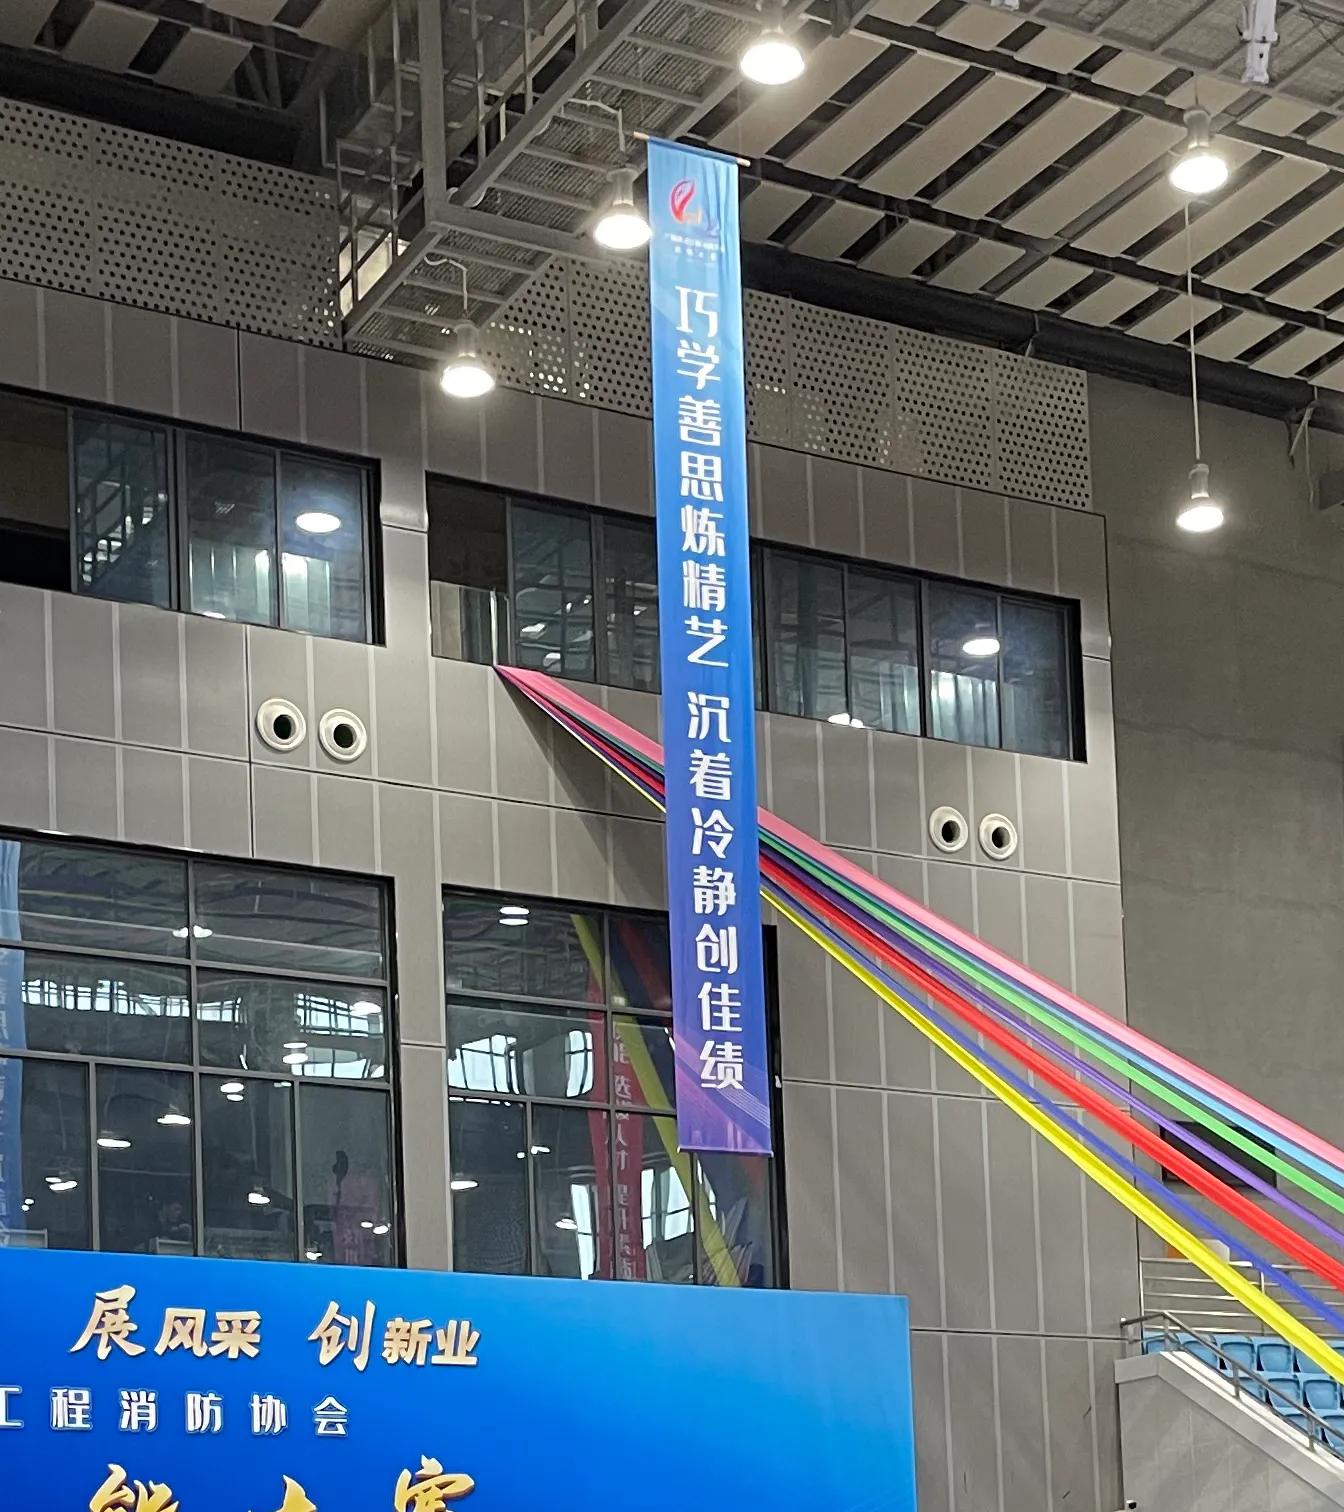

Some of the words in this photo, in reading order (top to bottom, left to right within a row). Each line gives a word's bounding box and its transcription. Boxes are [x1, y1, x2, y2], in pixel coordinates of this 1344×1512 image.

[674, 285, 729, 668] 巧学善思炼精艺
[687, 690, 745, 1091] 沉着冷静创佳绩
[70, 1283, 262, 1361] 展风采
[309, 1299, 481, 1372] 创新业
